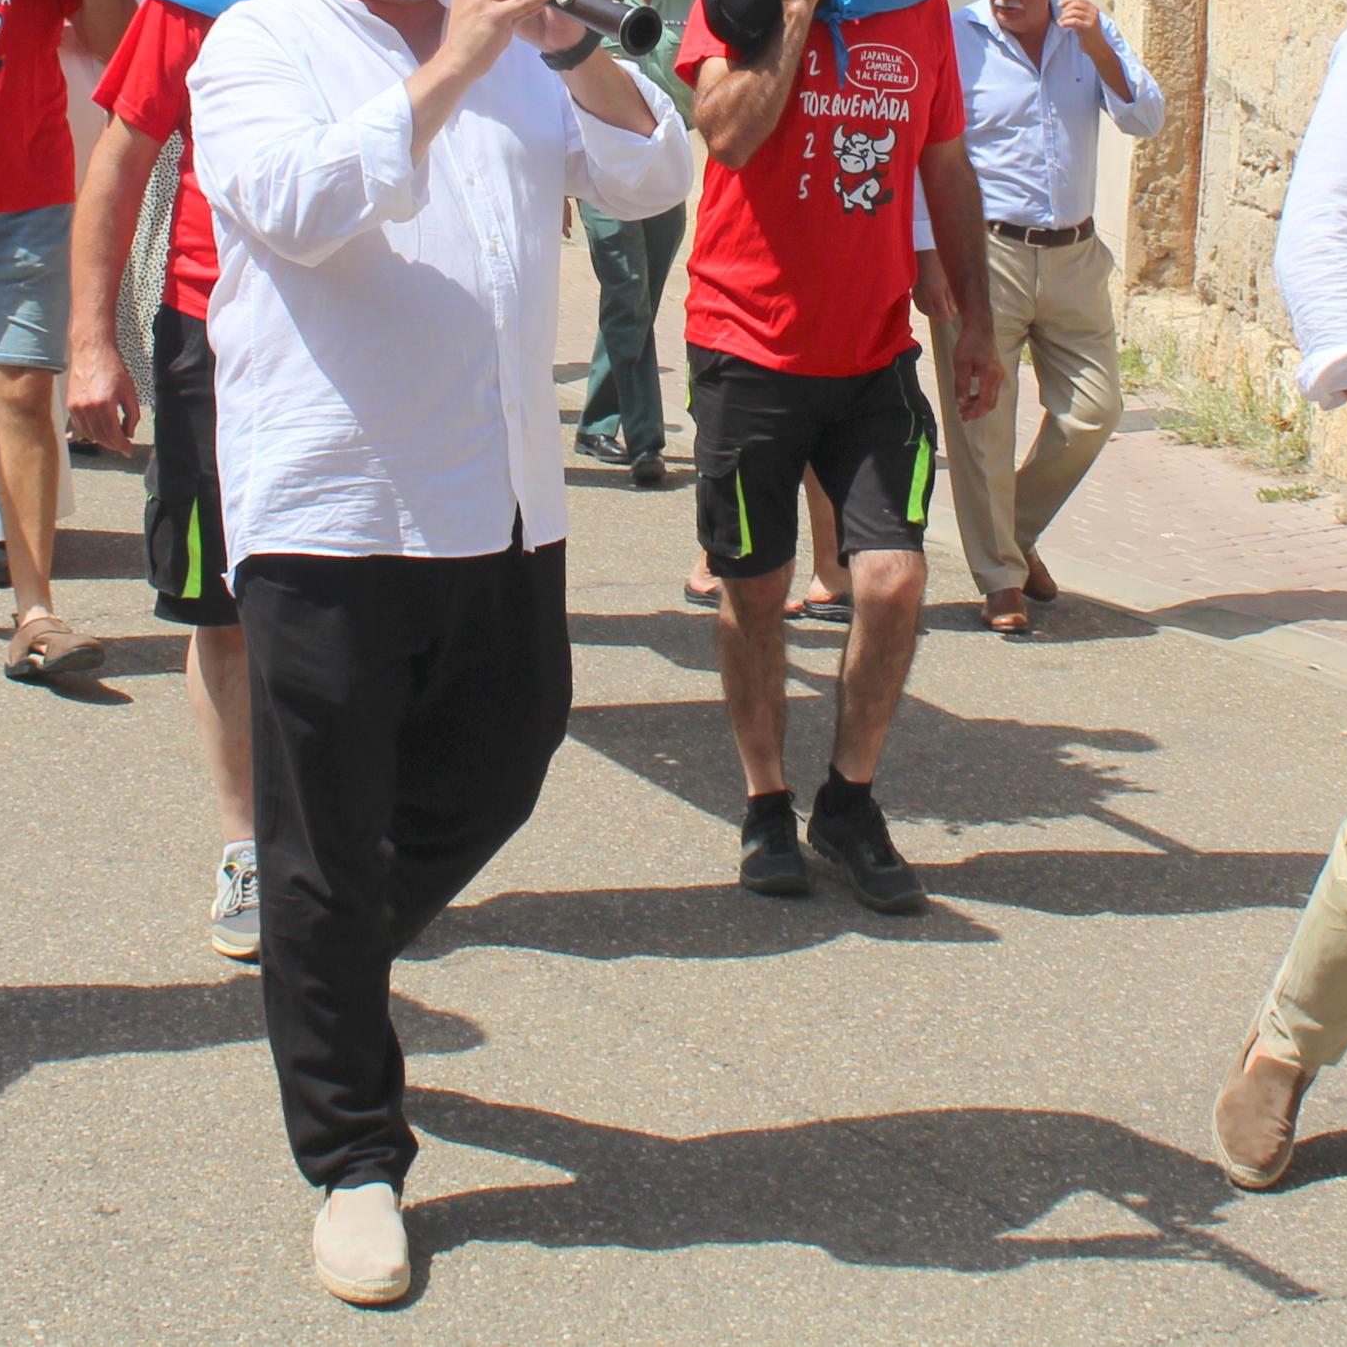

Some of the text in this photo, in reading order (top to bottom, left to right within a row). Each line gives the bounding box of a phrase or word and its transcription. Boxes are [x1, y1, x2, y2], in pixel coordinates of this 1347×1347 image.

[808, 50, 821, 76] 2
[800, 91, 910, 122] TORQUEMADA
[803, 132, 815, 158] 2
[798, 174, 811, 199] 5
